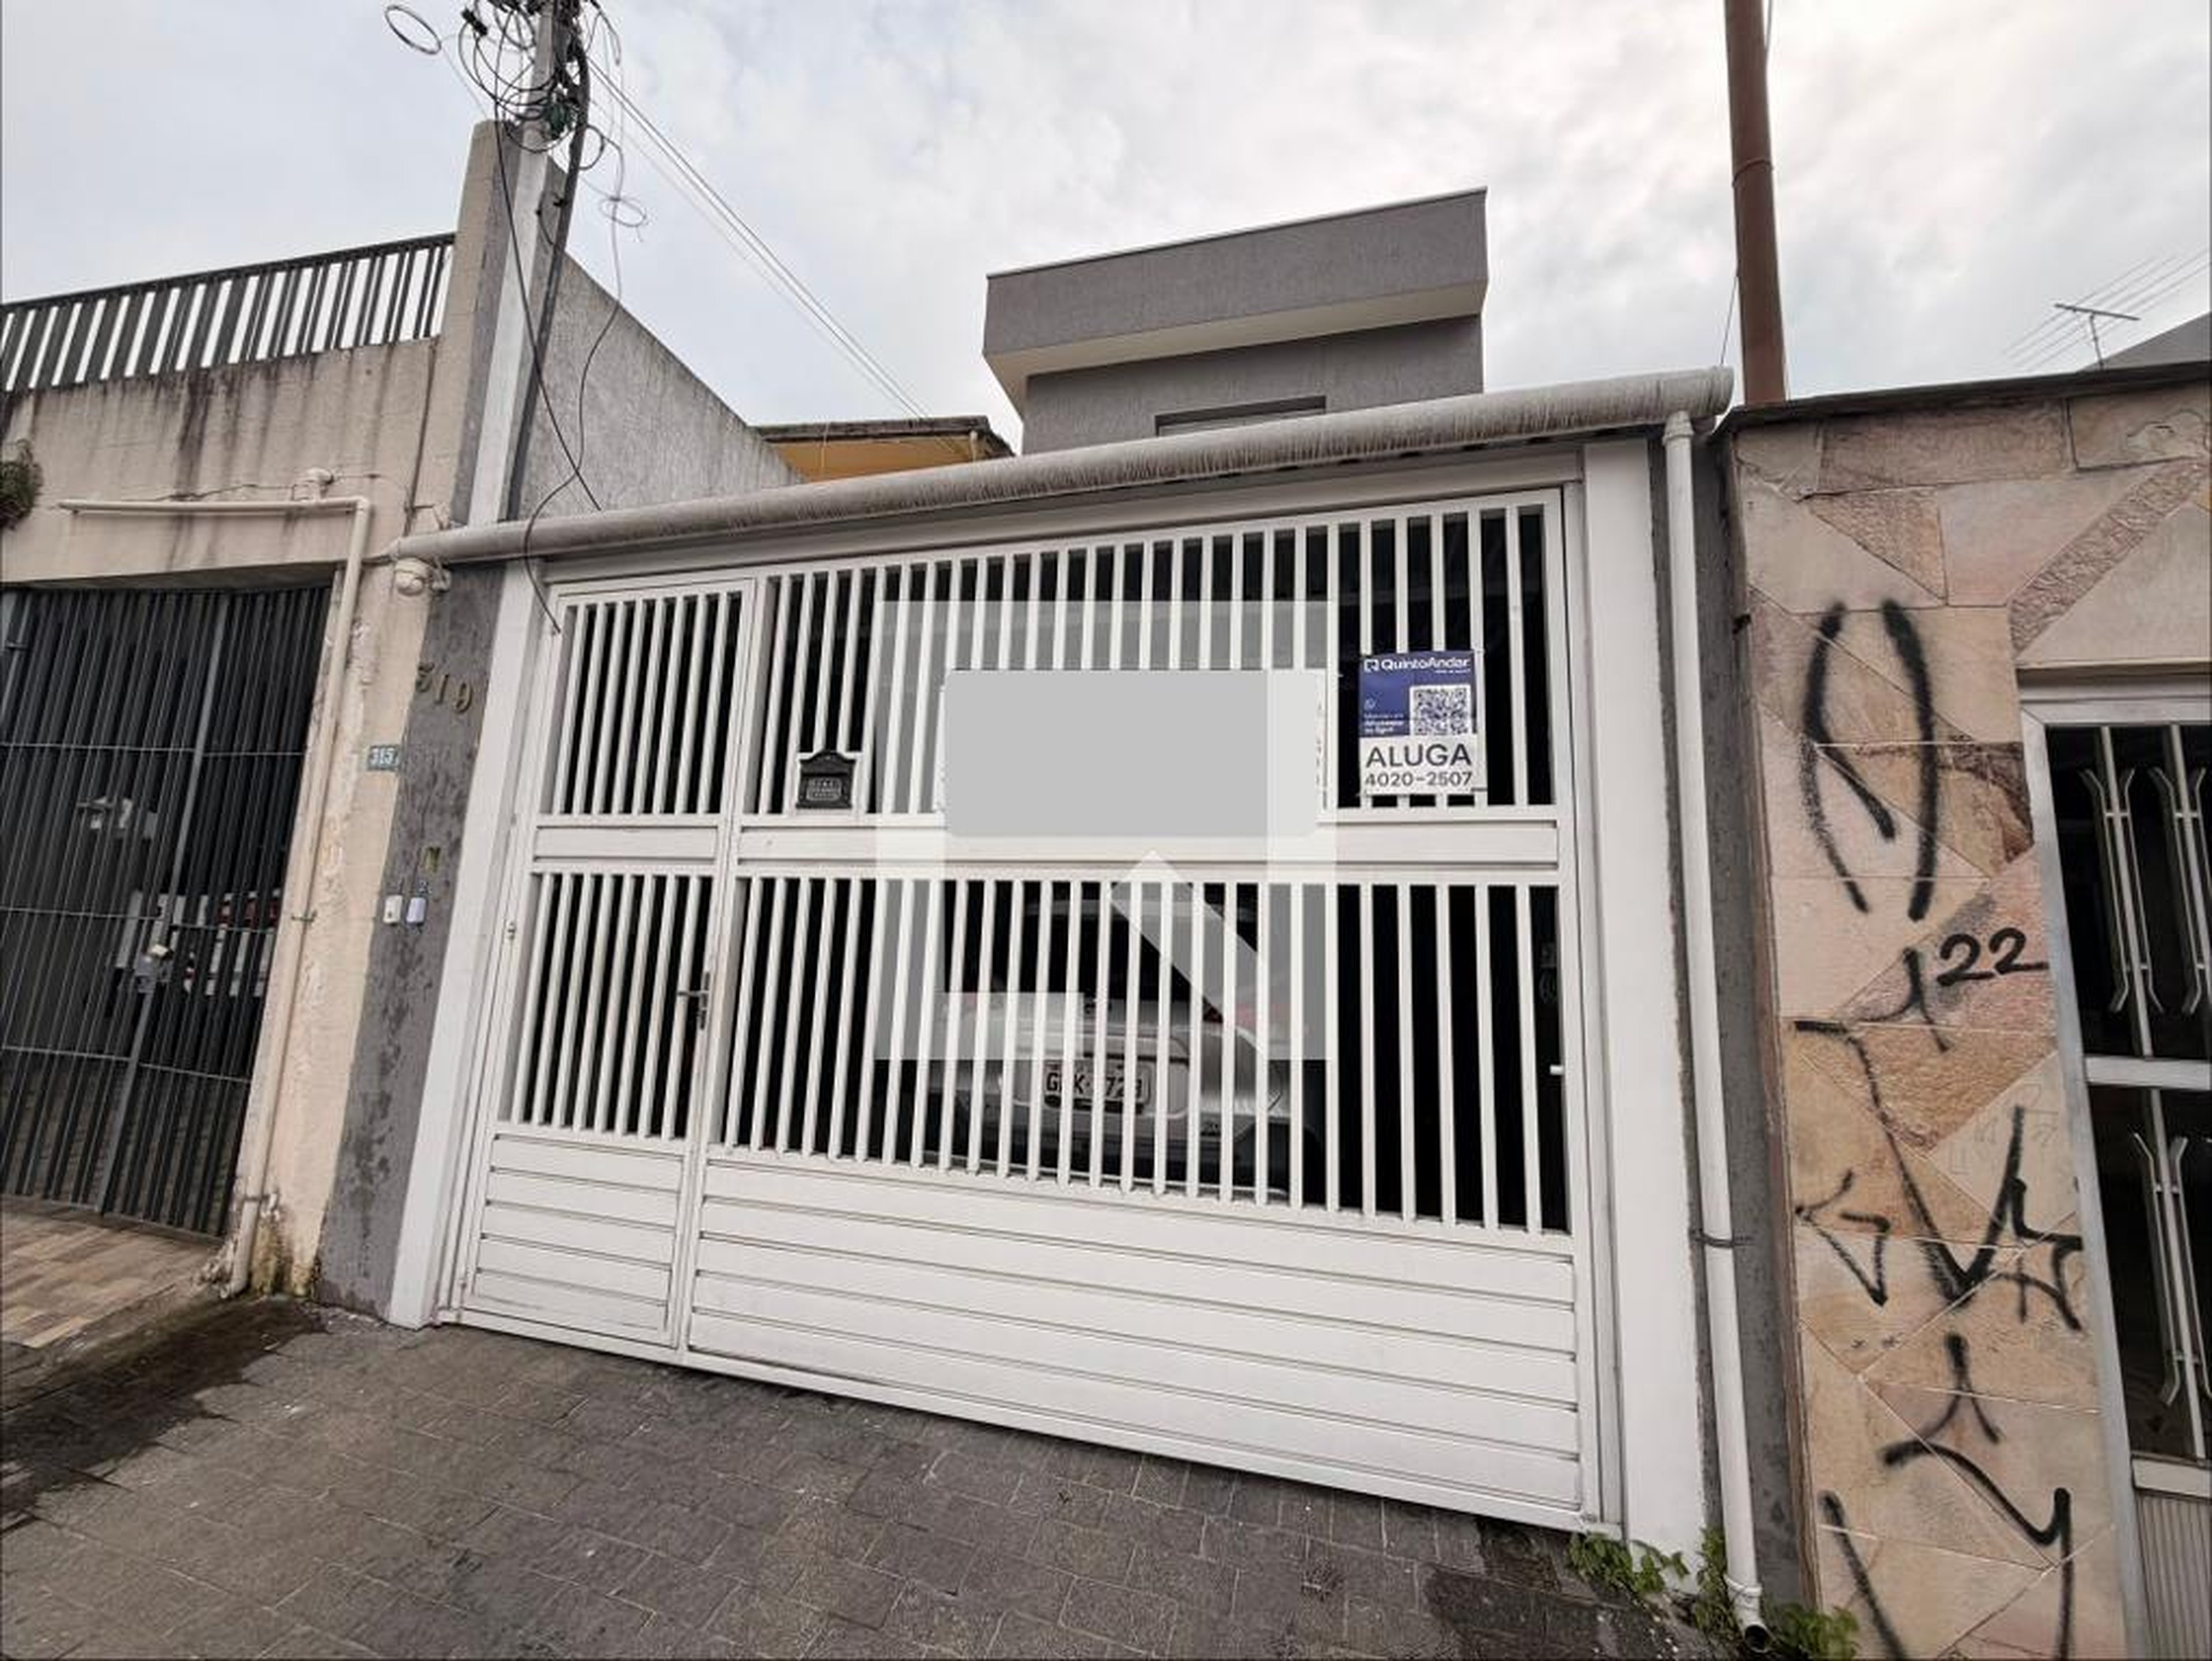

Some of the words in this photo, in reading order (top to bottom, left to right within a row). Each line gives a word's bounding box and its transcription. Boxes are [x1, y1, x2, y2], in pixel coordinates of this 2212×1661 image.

[1381, 657, 1469, 671] QuintoAndar
[1366, 744, 1471, 767] ALUGA
[1365, 771, 1472, 786] 4020-2507
